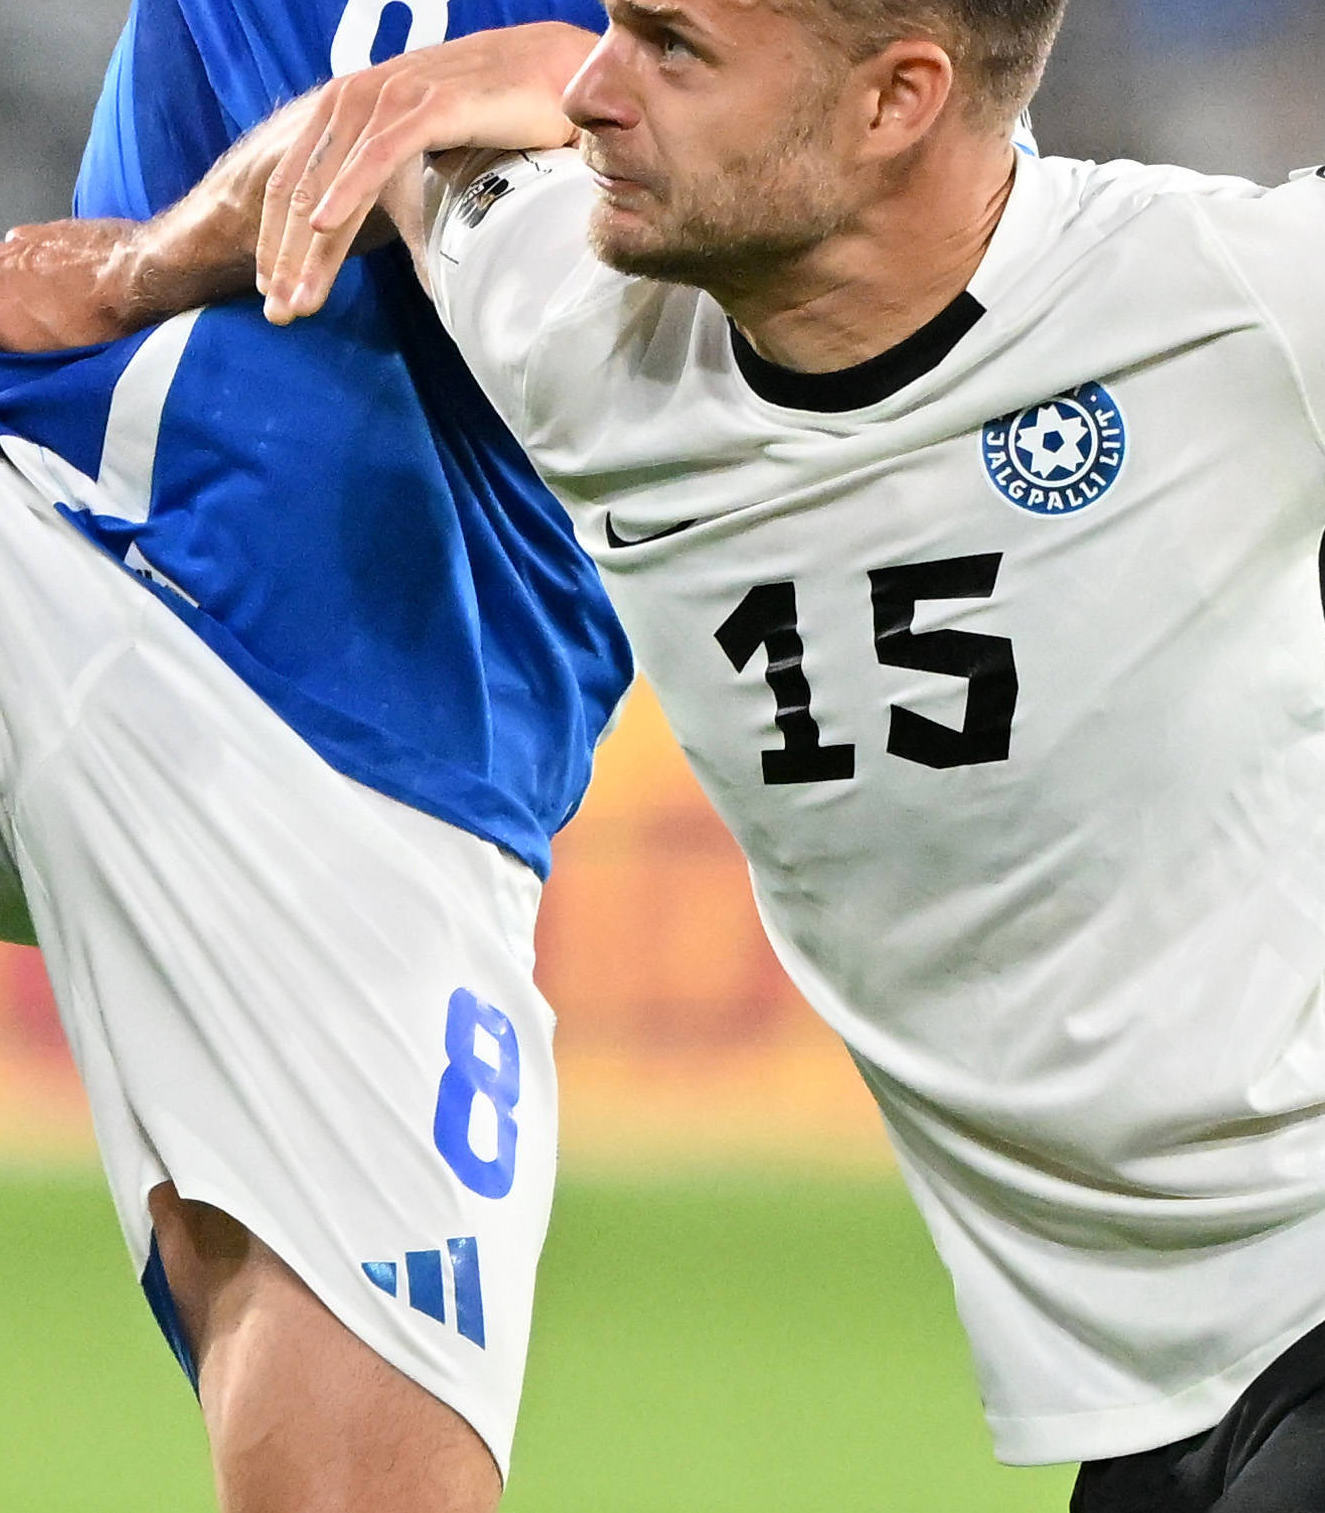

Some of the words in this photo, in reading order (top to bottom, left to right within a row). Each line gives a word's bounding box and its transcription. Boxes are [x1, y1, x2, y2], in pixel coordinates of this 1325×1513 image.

[986, 431, 1107, 510] JALGPALLI
[1094, 408, 1122, 466] LIIT
[712, 552, 1019, 785] 15
[433, 987, 520, 1199] 8
